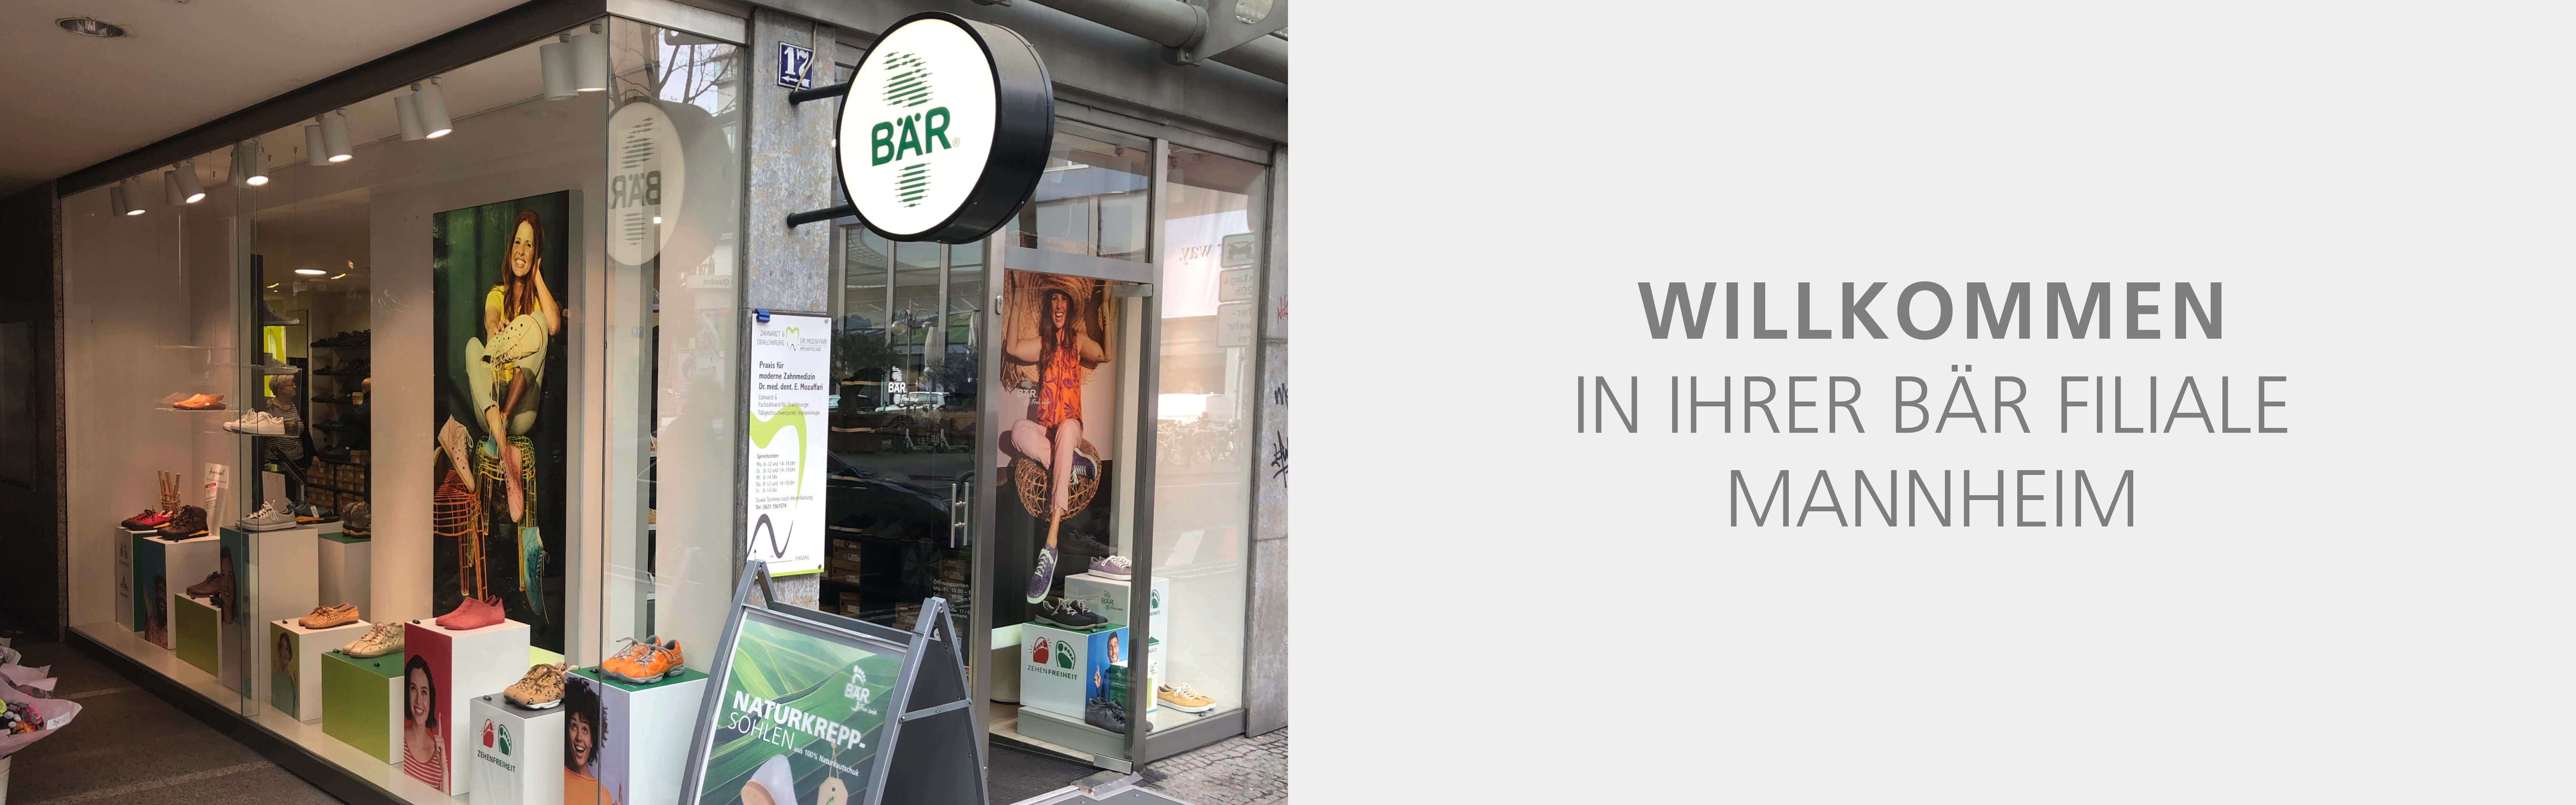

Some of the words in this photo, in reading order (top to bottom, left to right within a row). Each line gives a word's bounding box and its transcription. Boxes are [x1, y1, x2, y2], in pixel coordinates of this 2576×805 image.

[784, 47, 809, 77] 17
[872, 106, 952, 167] BÄR
[888, 382, 906, 393] BÄR
[1017, 389, 1036, 398] BÄR
[933, 579, 969, 588] Öffnungszeiten
[844, 683, 869, 703] BÄR
[728, 712, 795, 750] SOHLEN
[733, 690, 866, 750] NATURKREPP-
[477, 750, 515, 773] ZEHENFREIHEIT
[804, 749, 818, 760] 100%
[819, 755, 859, 777] Naturkautschuk
